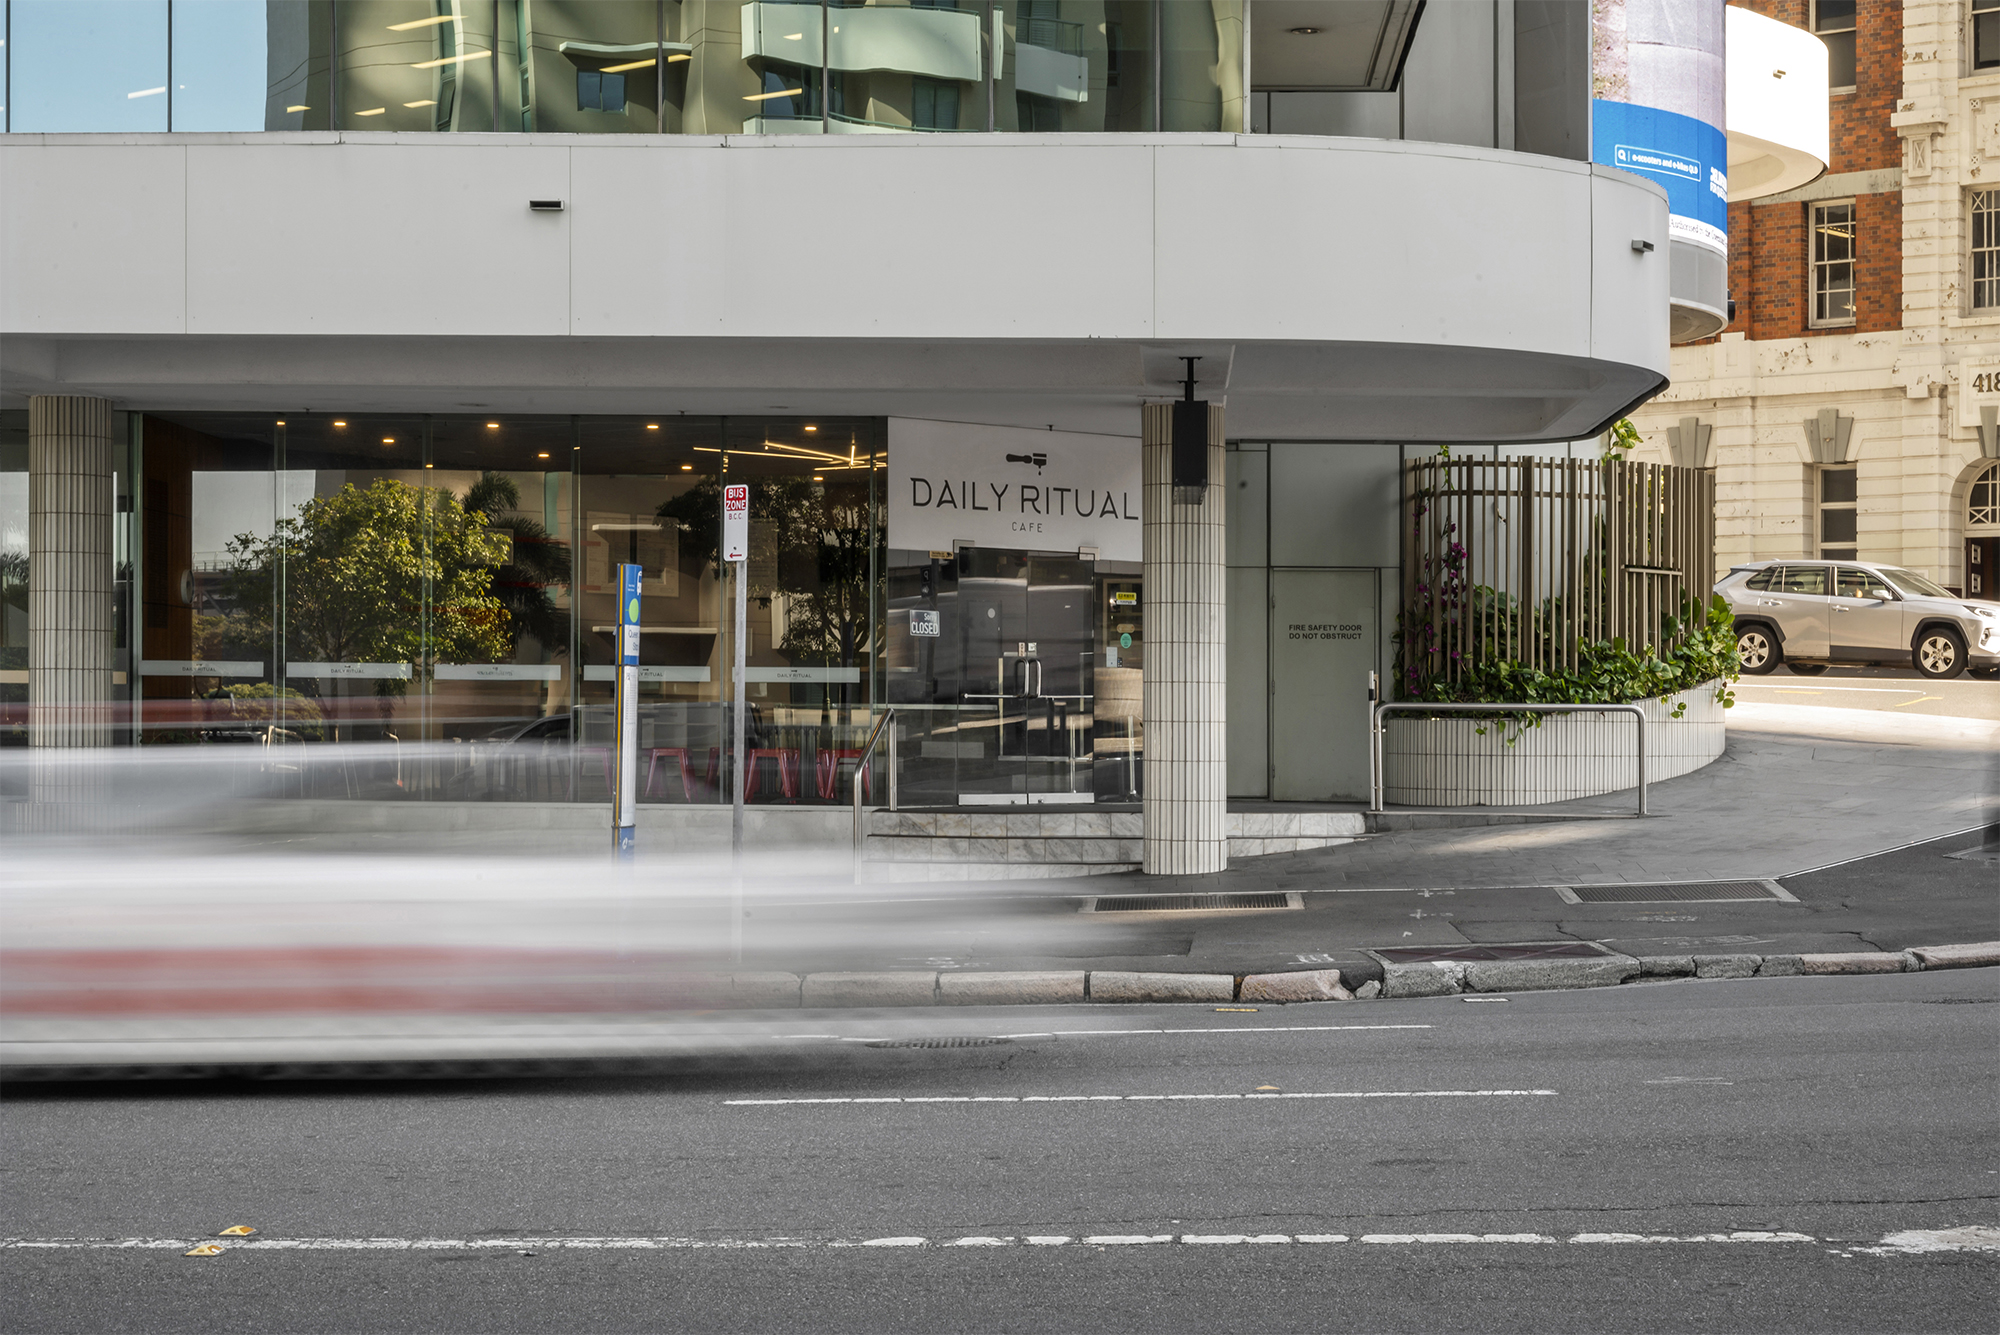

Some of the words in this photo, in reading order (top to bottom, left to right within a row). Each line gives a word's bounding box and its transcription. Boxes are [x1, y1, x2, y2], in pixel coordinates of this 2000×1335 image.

[1632, 154, 1662, 166] e-scooters
[1662, 159, 1672, 168] and
[1689, 164, 1698, 175] QLD
[728, 488, 744, 499] BUS
[909, 477, 1009, 512] DAILY
[1020, 484, 1139, 521] RITUAL
[726, 500, 746, 510] ZONE
[1011, 521, 1043, 533] CAFE
[911, 622, 938, 634] CLOSED
